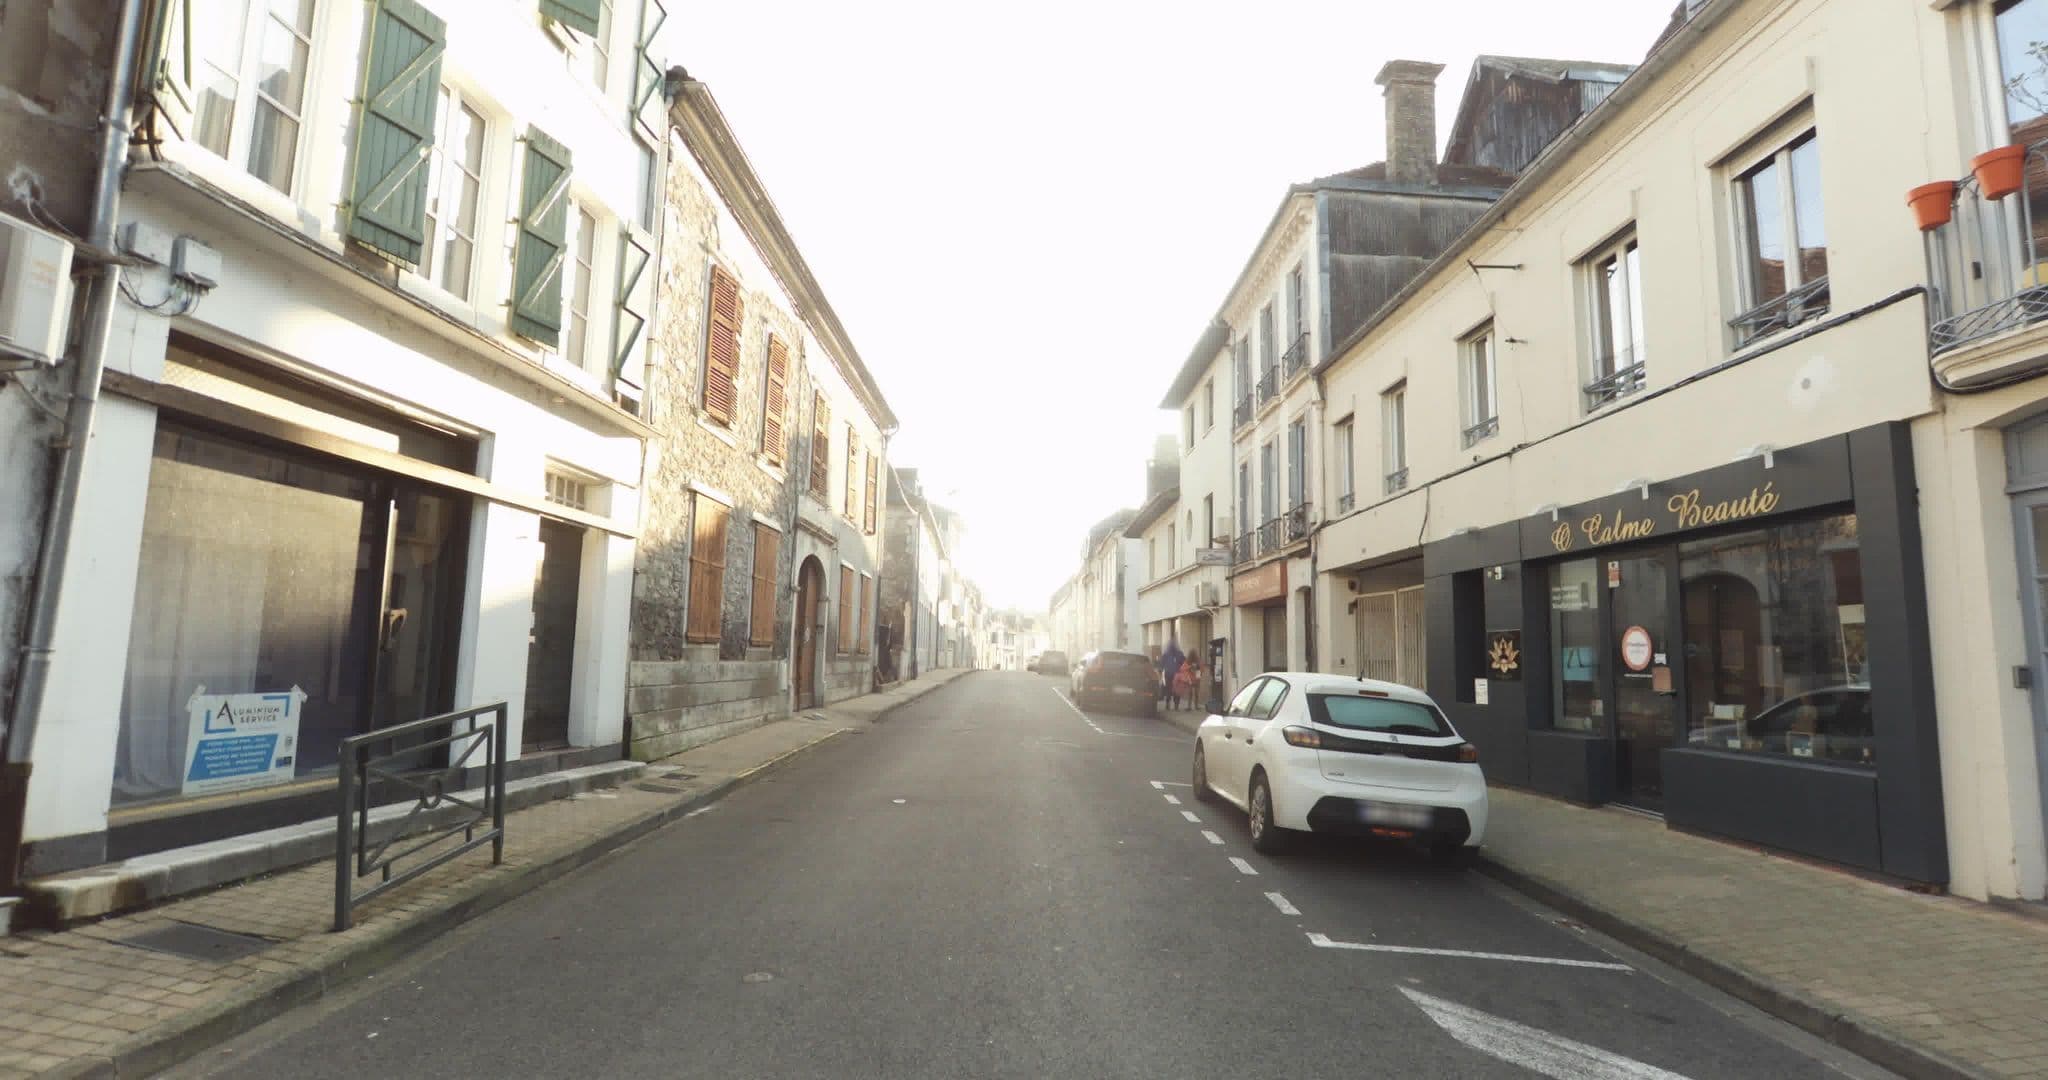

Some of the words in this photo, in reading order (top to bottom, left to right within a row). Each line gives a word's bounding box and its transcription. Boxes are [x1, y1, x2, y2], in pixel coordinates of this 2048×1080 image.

[1582, 509, 1656, 545] Calme
[1667, 482, 1780, 529] Beauté
[240, 715, 276, 724] SERVICE
